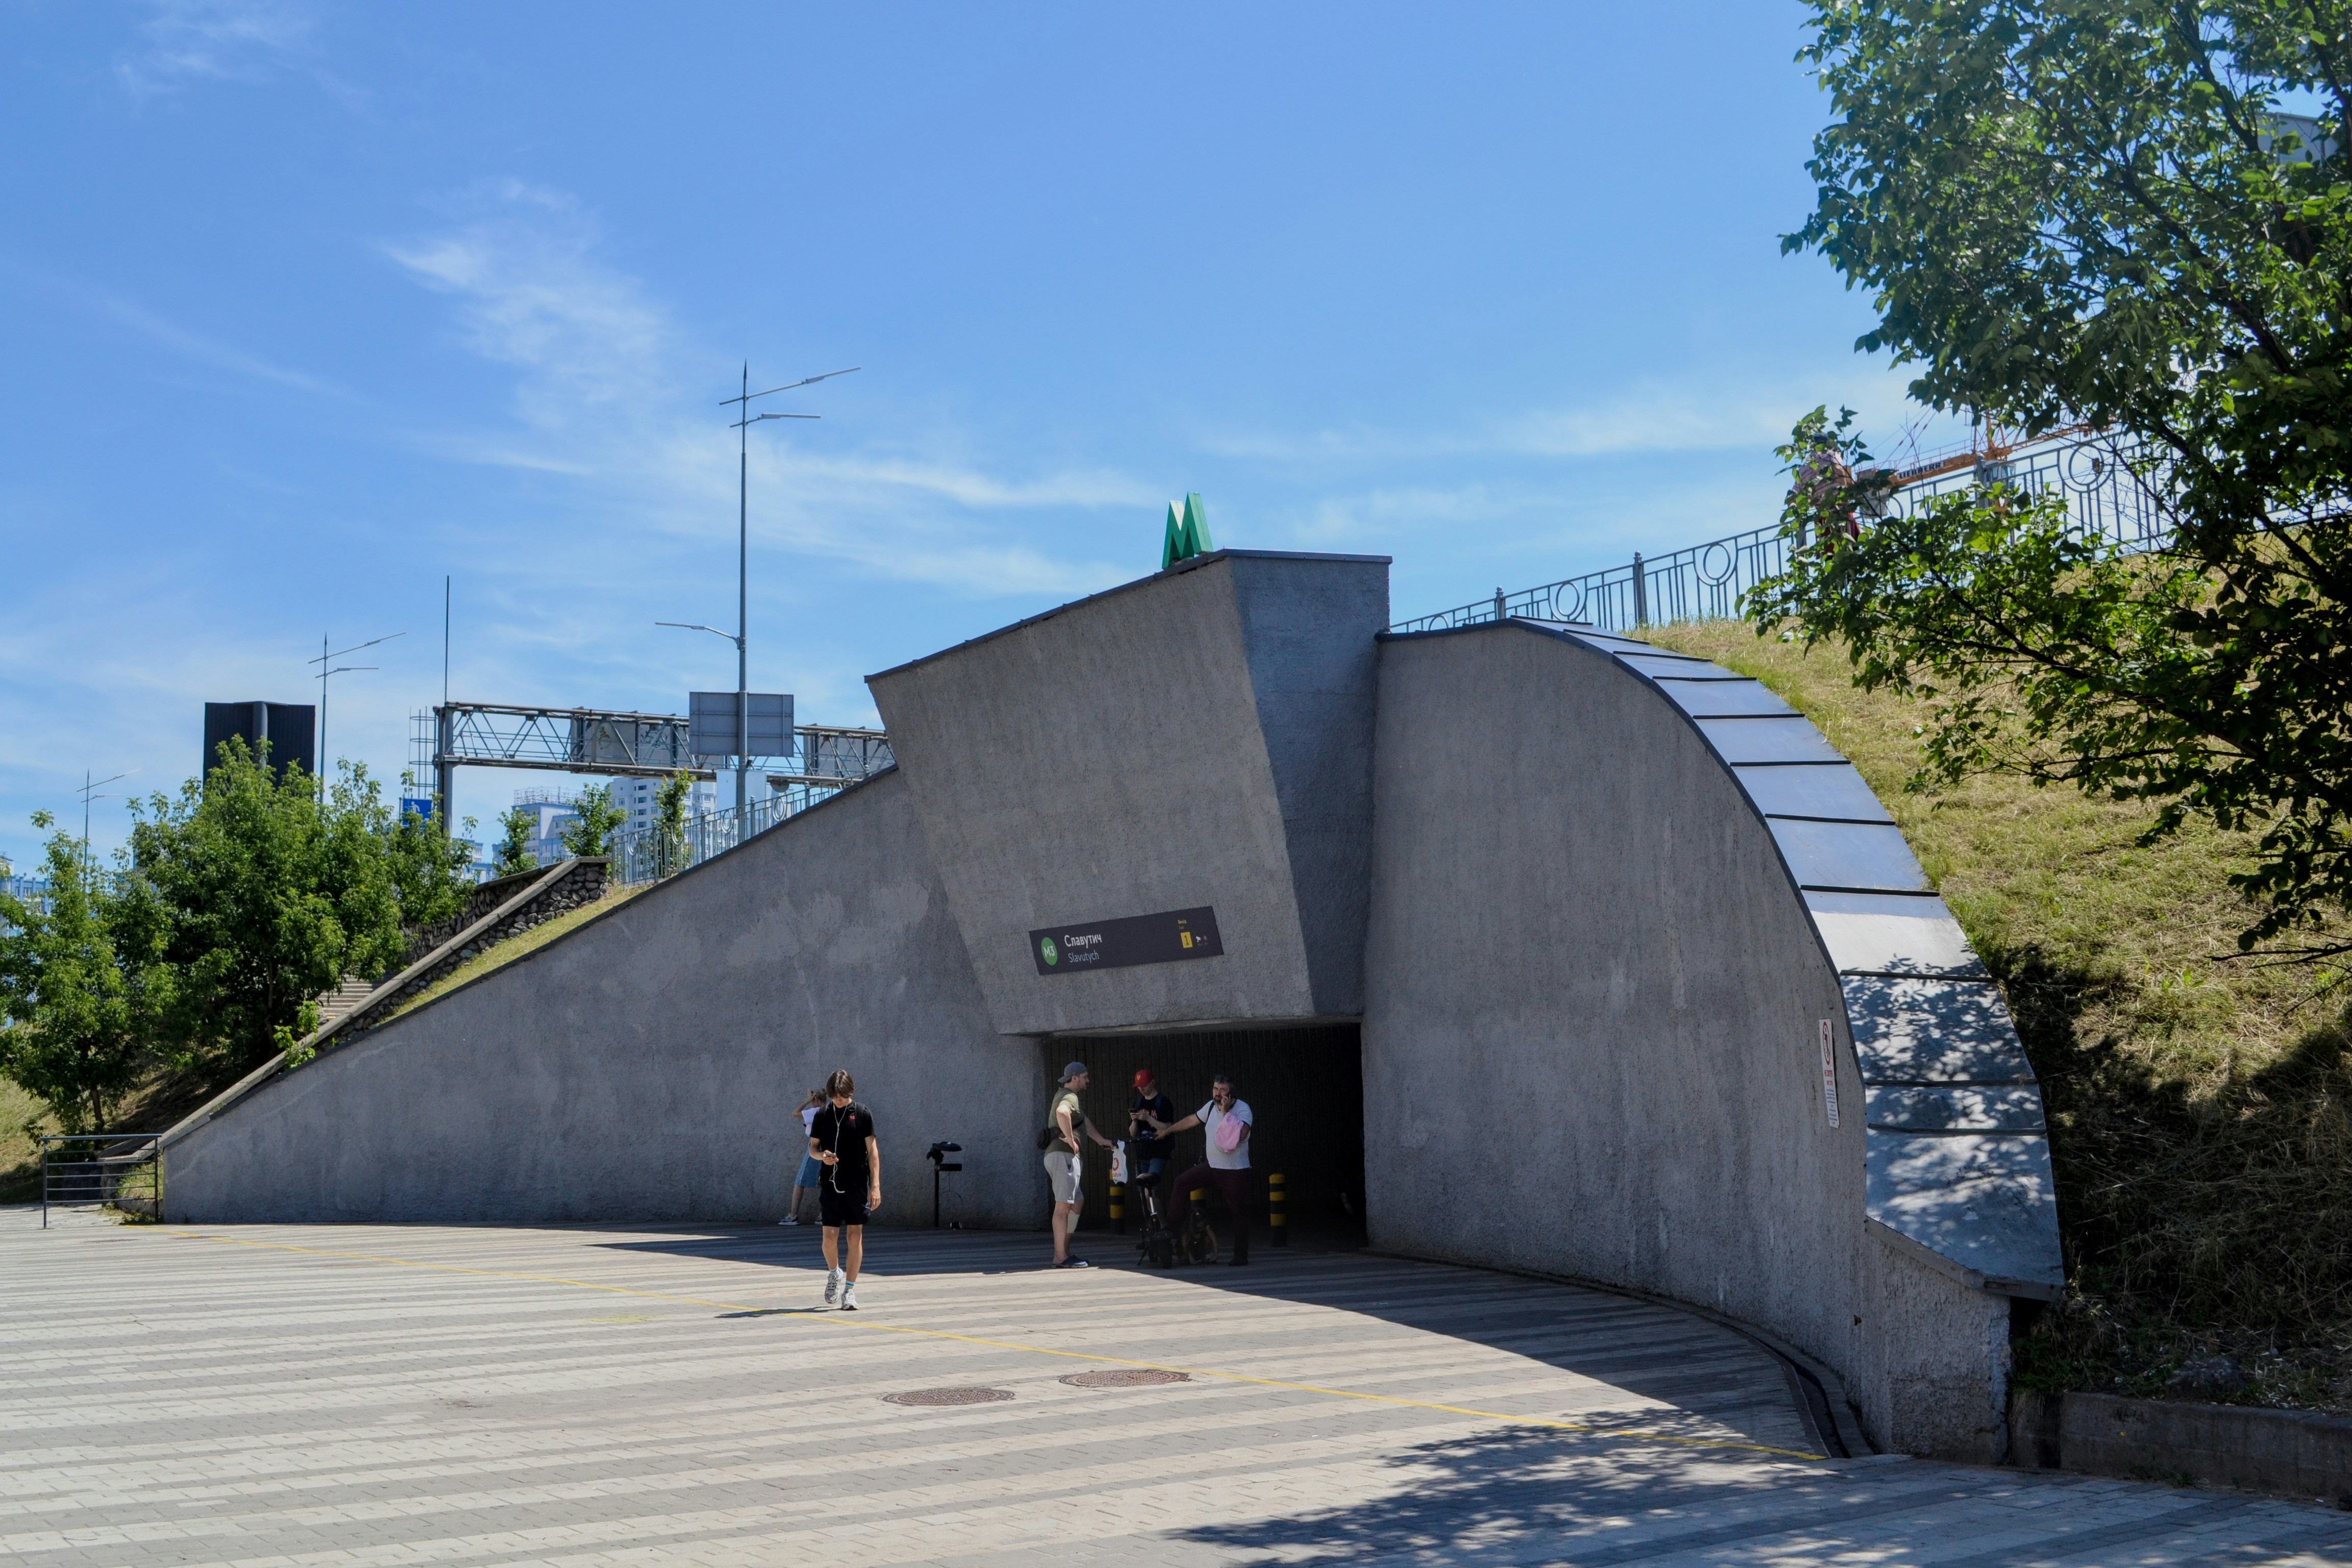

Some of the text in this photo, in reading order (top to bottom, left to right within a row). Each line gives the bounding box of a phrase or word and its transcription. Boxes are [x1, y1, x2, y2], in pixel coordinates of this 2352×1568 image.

[1064, 934, 1102, 948] Славутич
[1185, 935, 1189, 945] 1
[1068, 949, 1099, 963] Slavutych
